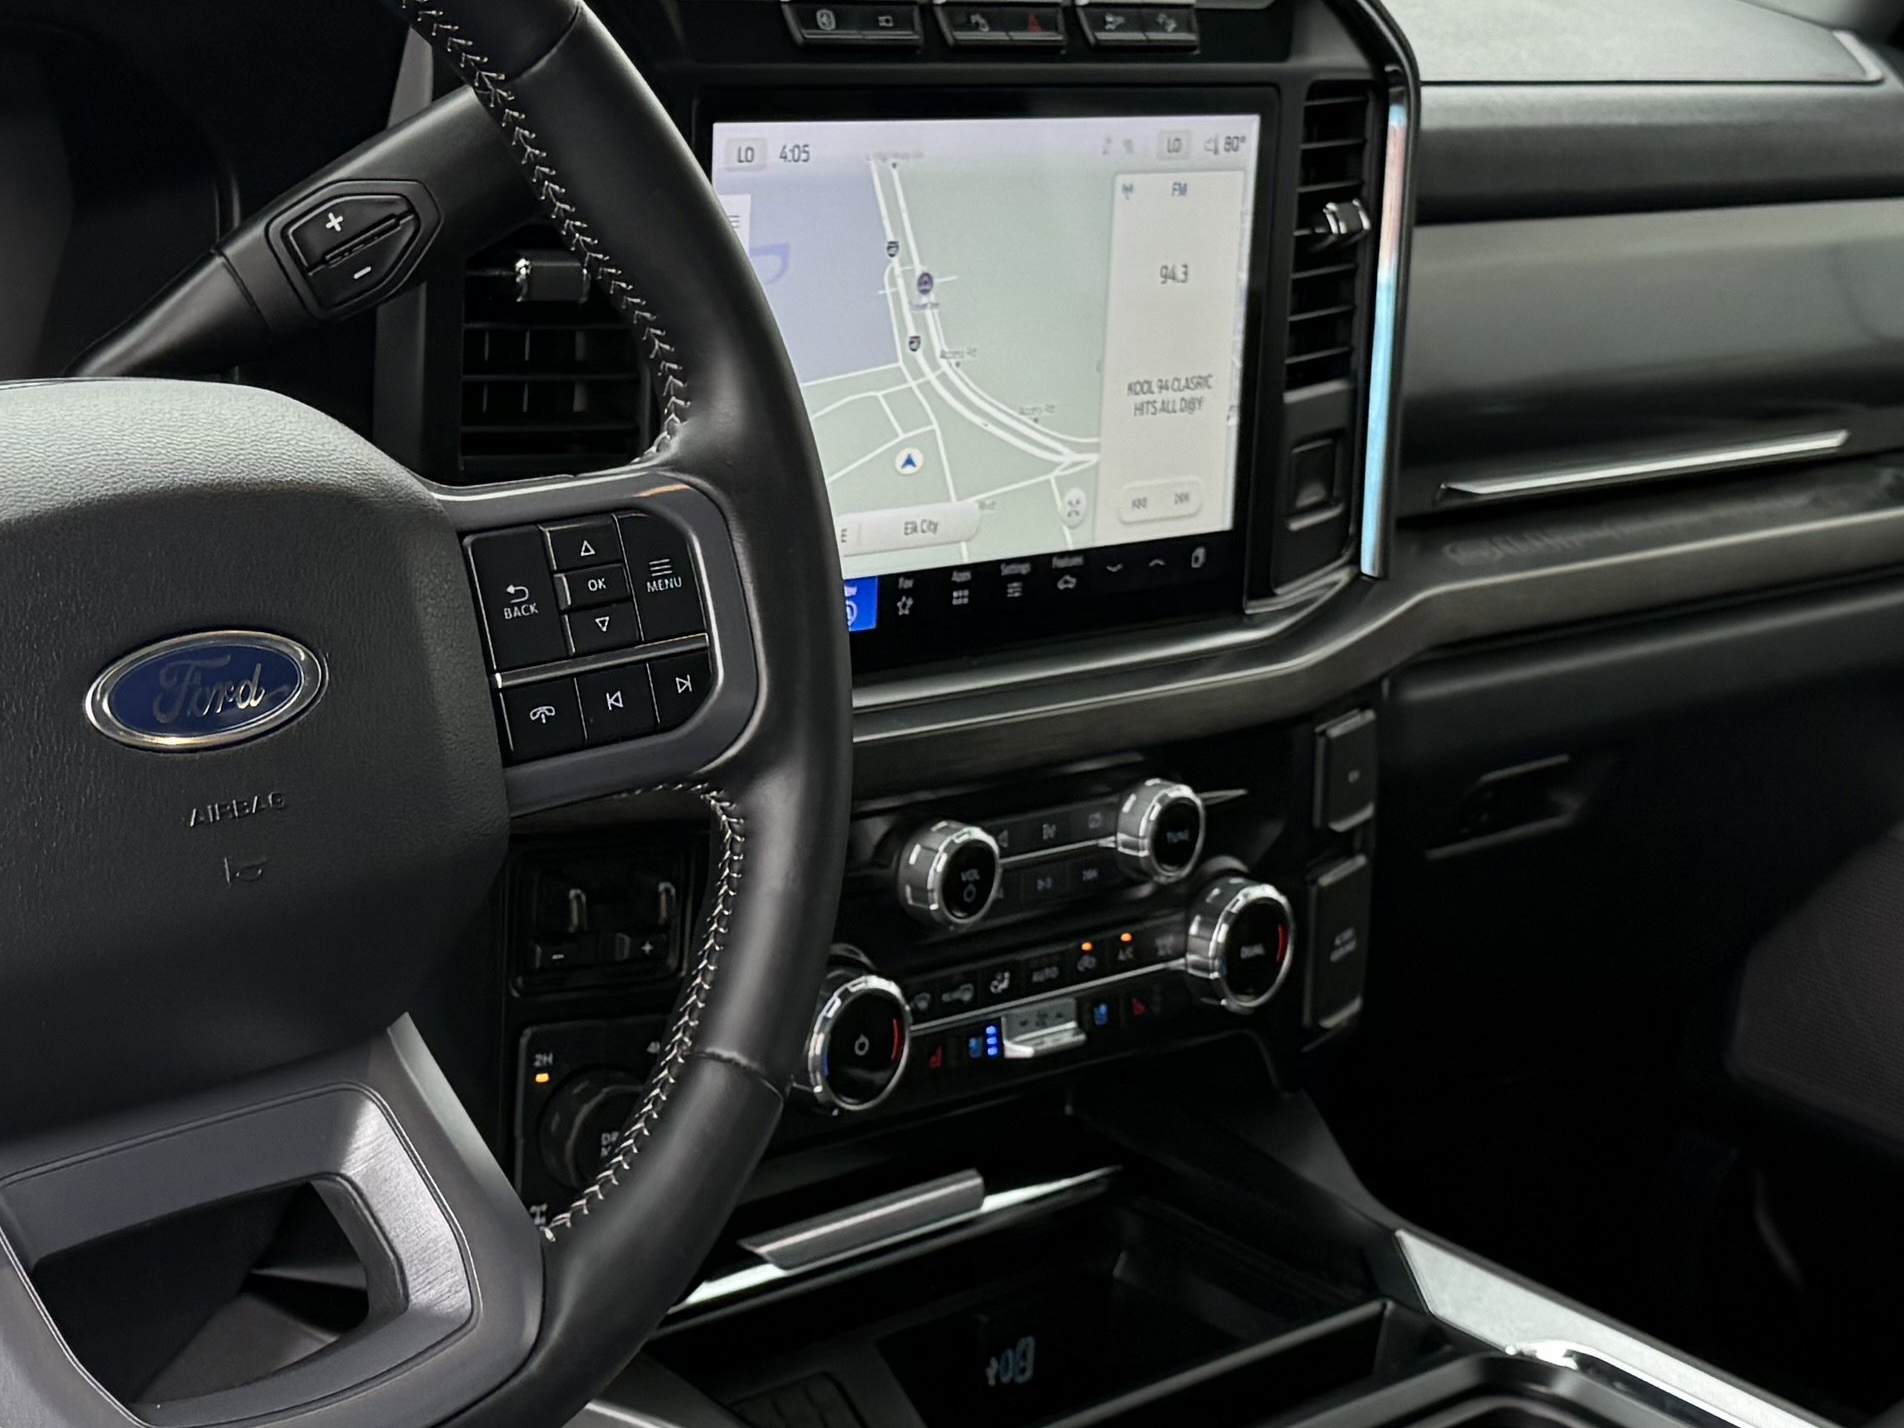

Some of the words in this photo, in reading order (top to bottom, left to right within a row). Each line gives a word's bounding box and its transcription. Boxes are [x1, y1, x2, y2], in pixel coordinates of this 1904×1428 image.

[779, 144, 811, 164] 4:05
[588, 577, 607, 592] OK
[647, 576, 683, 593] MENU
[503, 602, 539, 621] BACK
[152, 654, 266, 724] Ford
